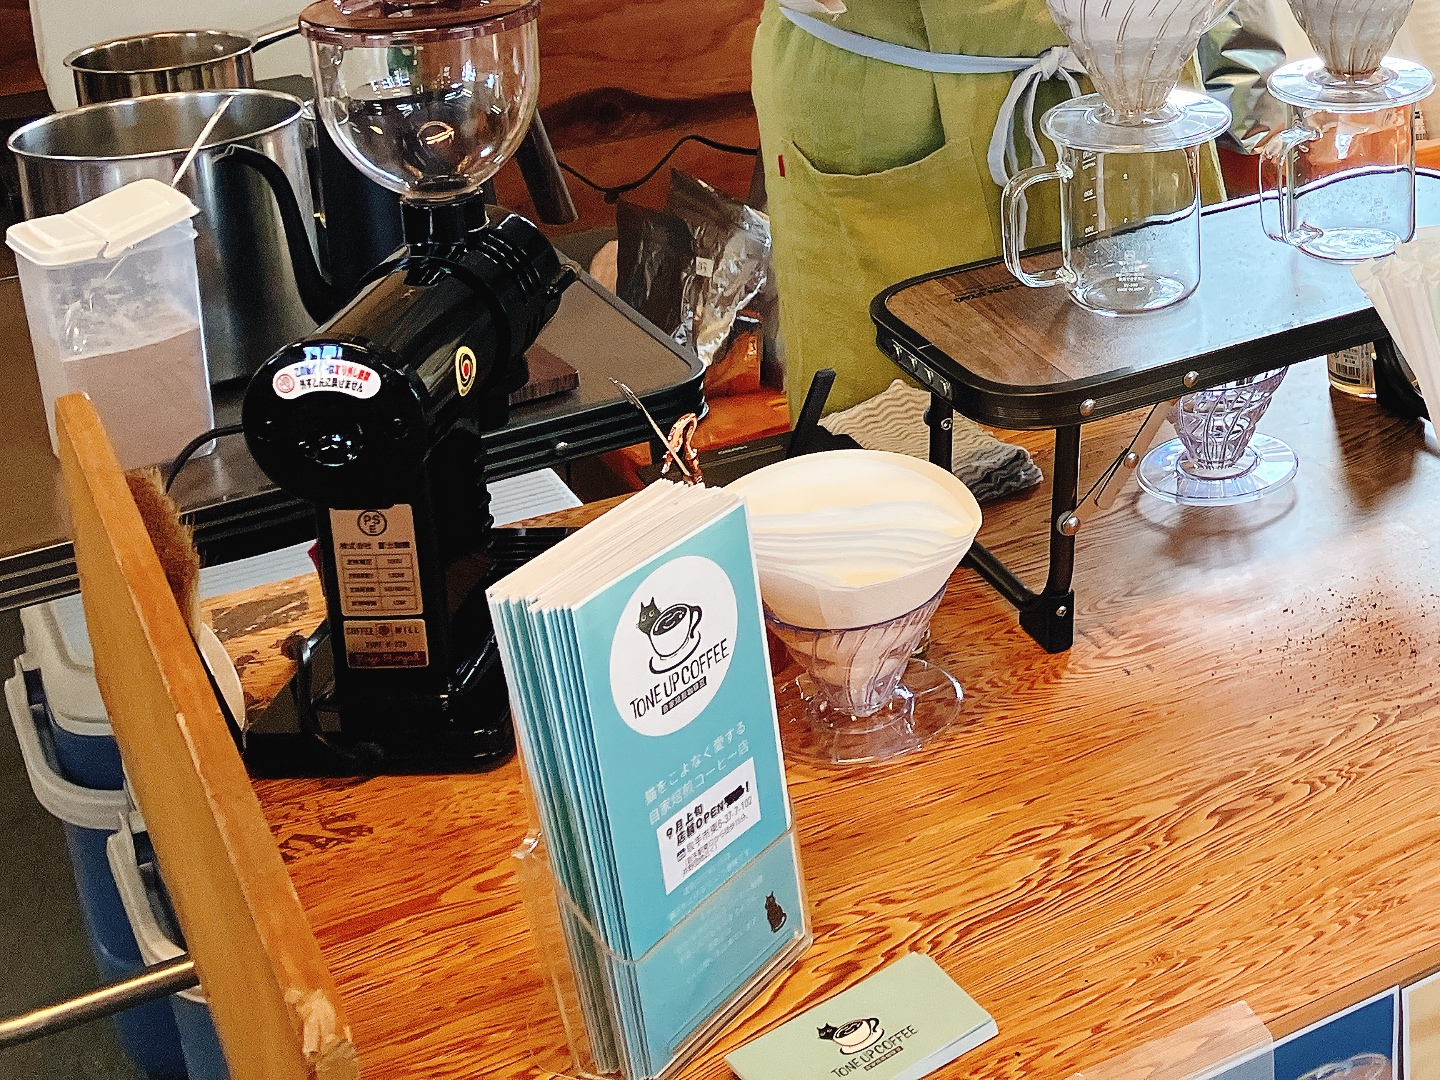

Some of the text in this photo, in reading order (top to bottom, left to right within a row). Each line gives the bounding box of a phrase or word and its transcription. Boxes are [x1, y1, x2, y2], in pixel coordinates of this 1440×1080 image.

[630, 638, 729, 719] TONE UP COFFEE
[831, 1058, 860, 1077] TONE
[874, 1025, 918, 1054] COFFEE
